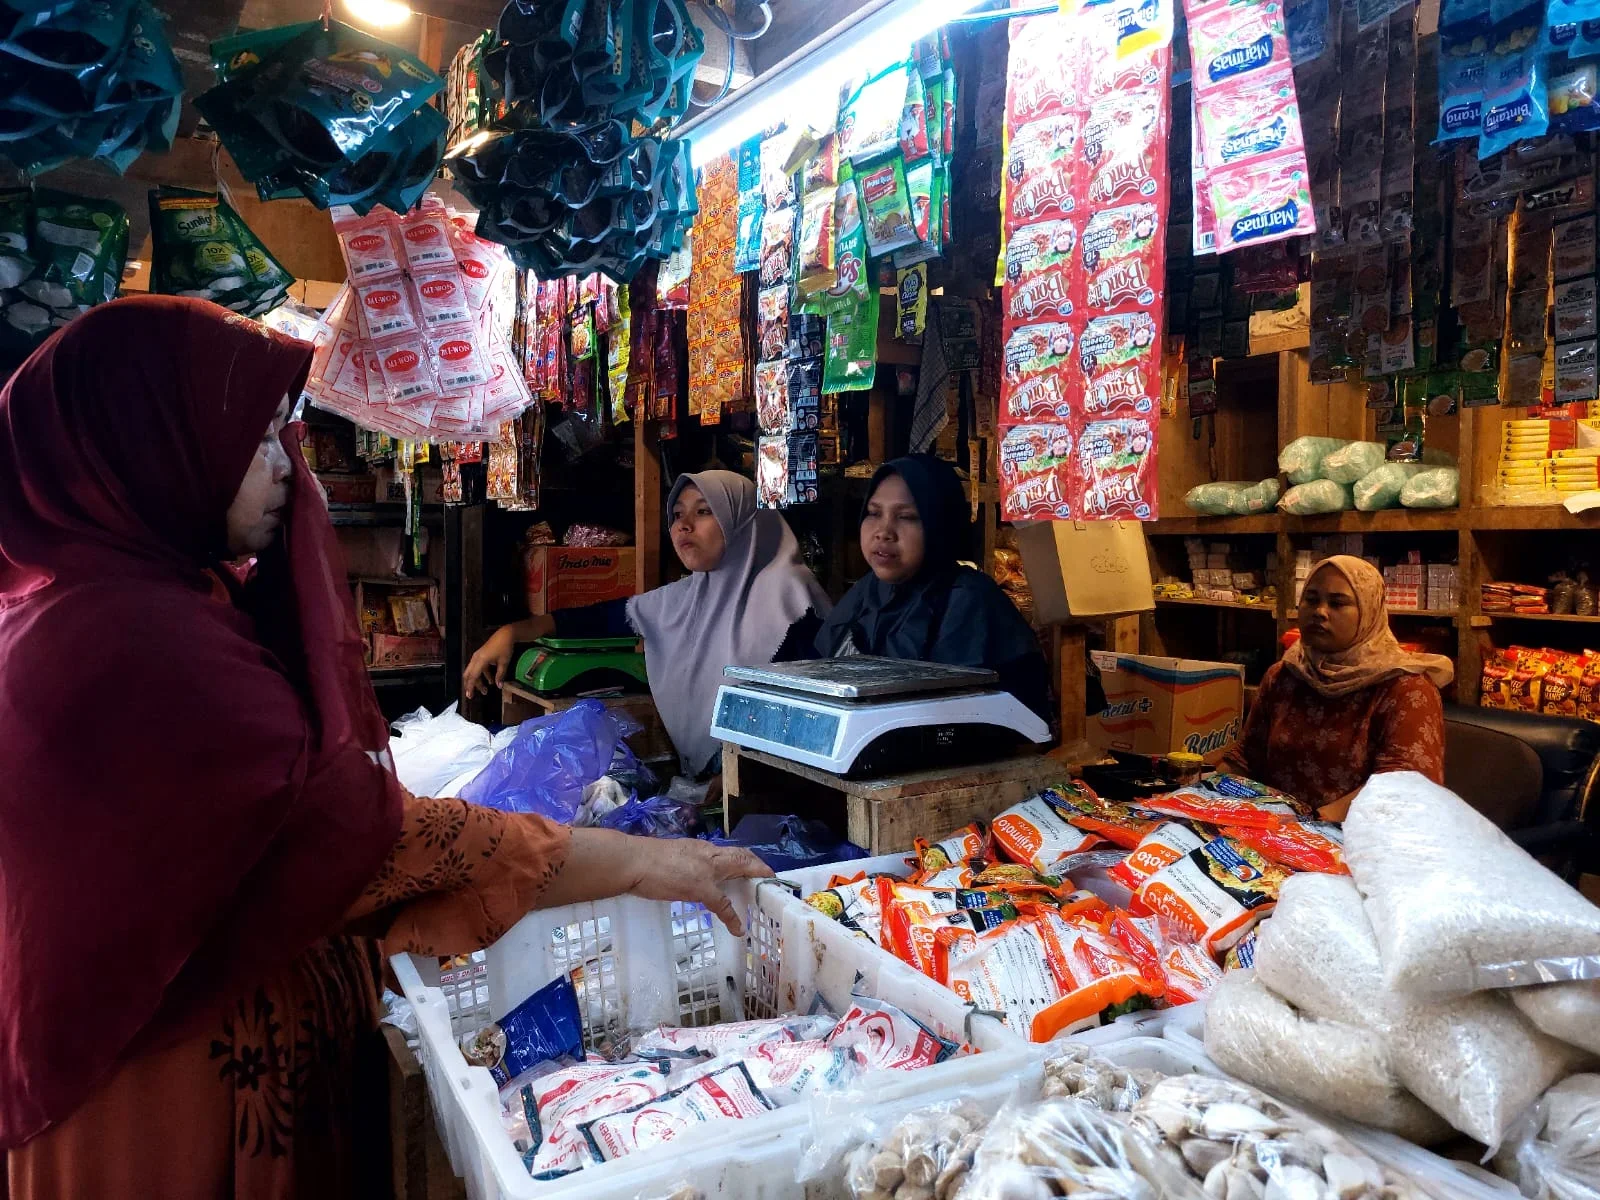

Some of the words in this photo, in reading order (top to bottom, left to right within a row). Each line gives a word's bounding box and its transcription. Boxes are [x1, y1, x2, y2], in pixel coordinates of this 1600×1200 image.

[1236, 209, 1294, 233] Marimas
[366, 294, 398, 305] MI-WON
[441, 345, 470, 356] MI-WON
[388, 354, 416, 368] MI-WON
